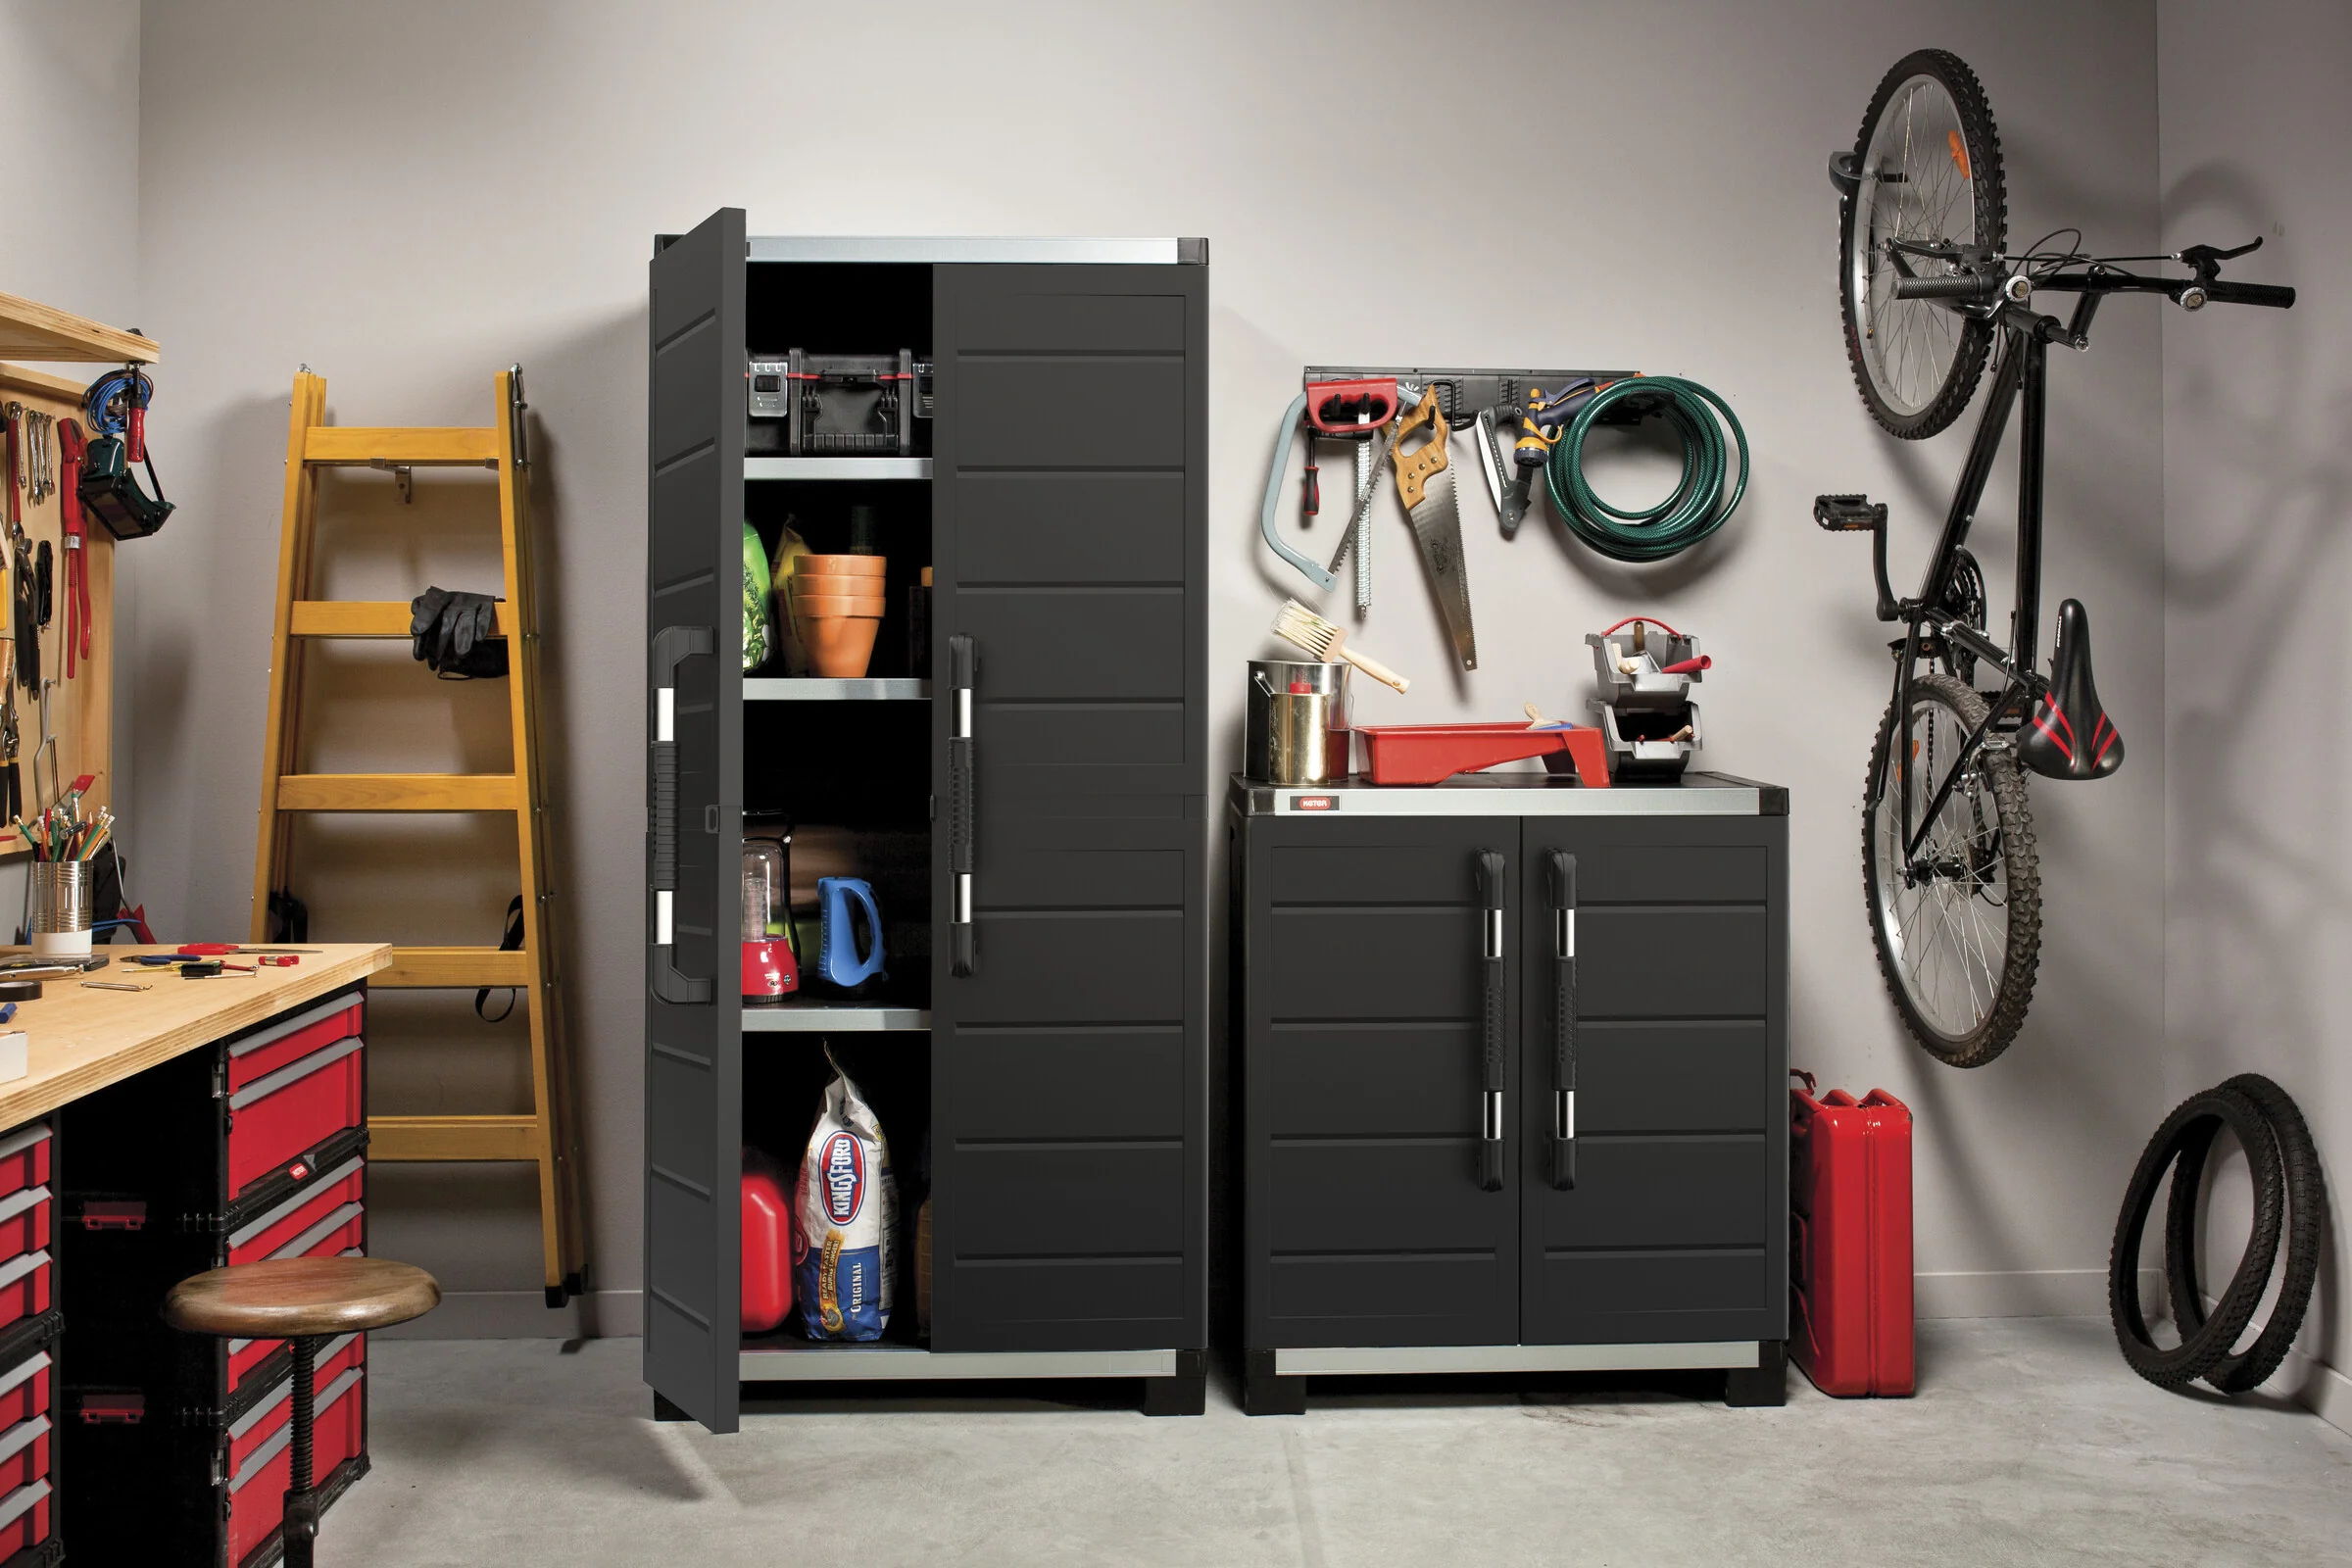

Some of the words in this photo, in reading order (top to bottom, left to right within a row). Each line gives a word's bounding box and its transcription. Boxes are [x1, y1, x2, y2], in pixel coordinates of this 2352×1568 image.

[826, 1139, 857, 1215] KINGSFORD
[823, 1240, 832, 1269] FASTER
[829, 1240, 840, 1267] LONGER!
[850, 1262, 862, 1313] ORIGINAL
